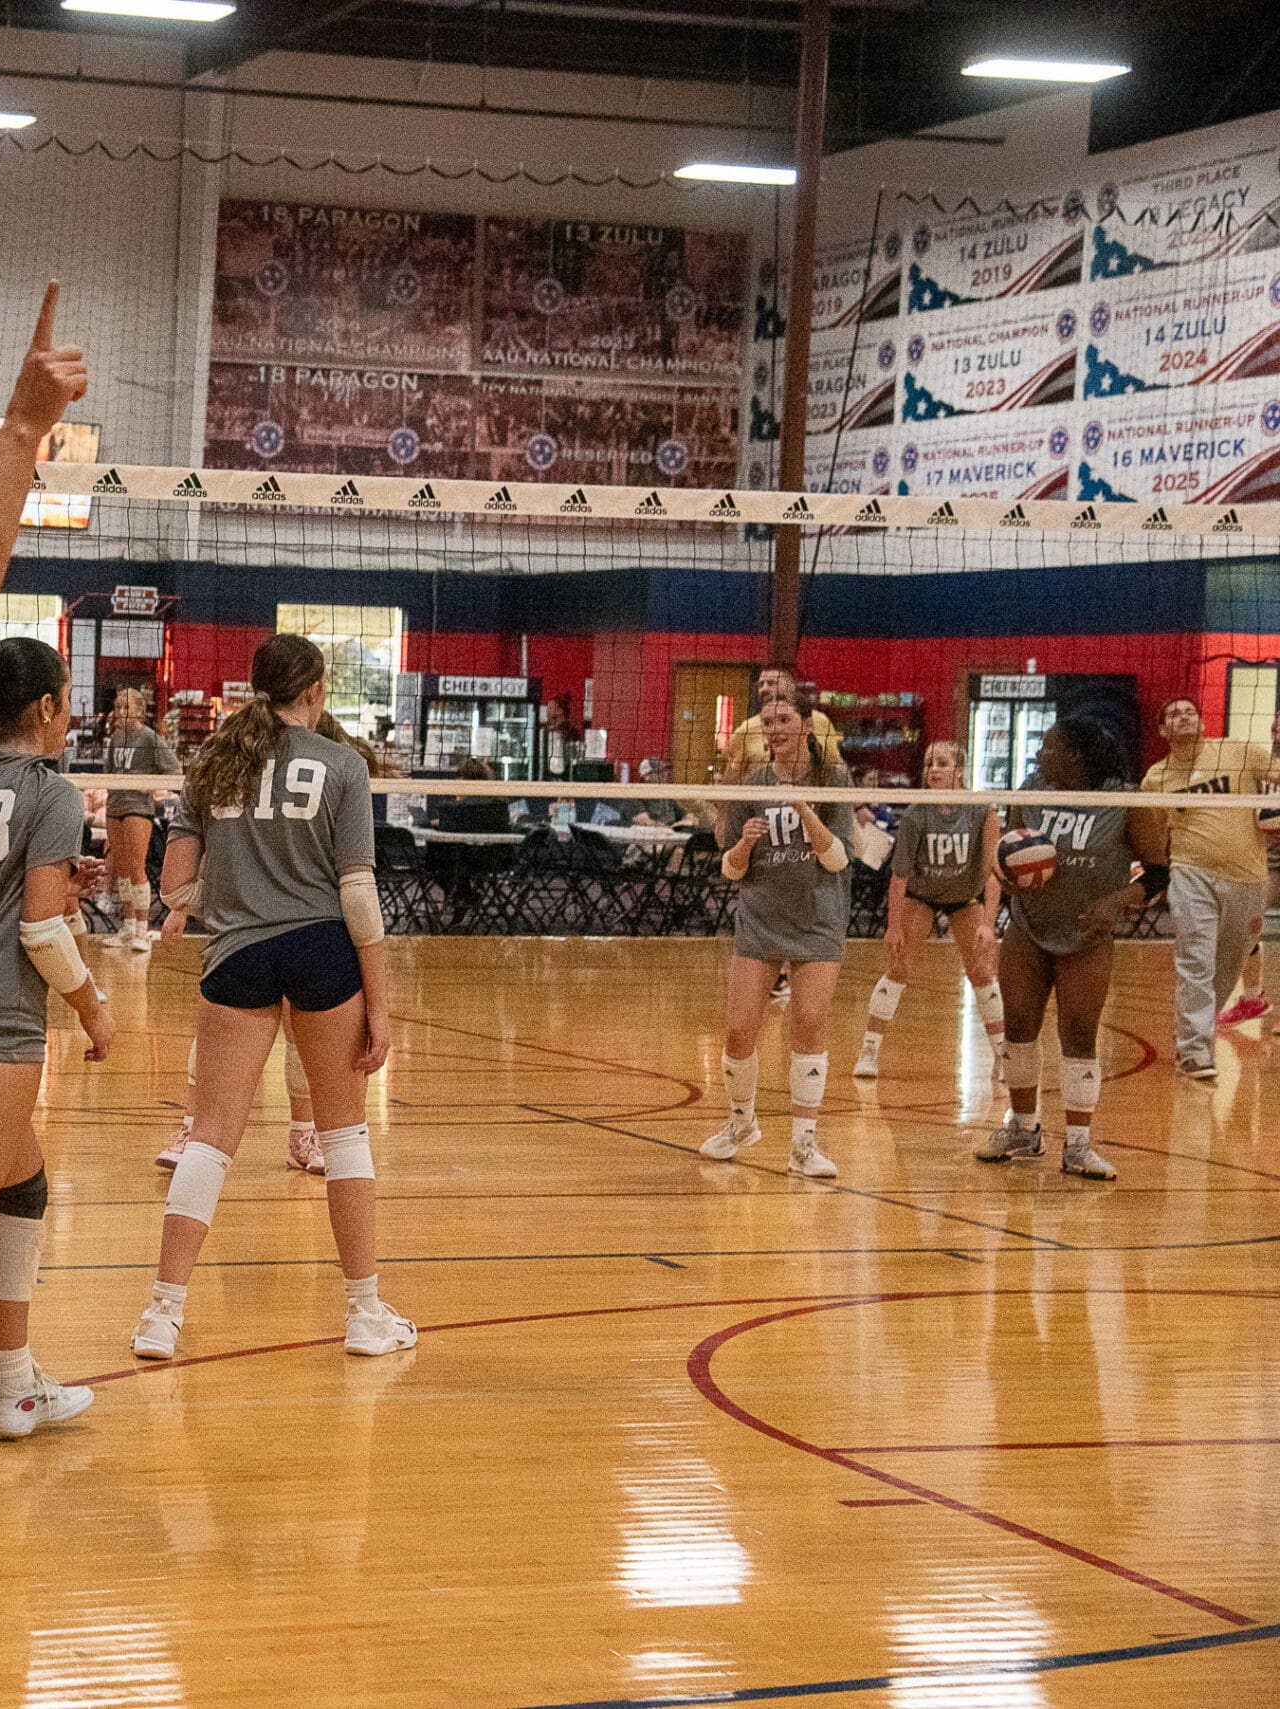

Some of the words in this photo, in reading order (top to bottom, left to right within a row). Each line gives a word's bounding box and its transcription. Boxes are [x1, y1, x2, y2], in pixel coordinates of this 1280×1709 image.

[1196, 165, 1241, 186] PLACE
[1169, 186, 1249, 220] LEGACY
[261, 205, 288, 224] 18
[299, 207, 420, 232] PARAGON
[566, 224, 591, 242] 13
[600, 226, 663, 246] ZULU
[960, 242, 977, 262] 14
[983, 233, 1028, 260] ZULU
[971, 263, 1013, 288] 2019
[1114, 301, 1177, 321] NATIONAL
[930, 335, 987, 352] NATIONAL
[989, 324, 1048, 343] CHAMPION
[1145, 325, 1166, 346] 14
[1172, 316, 1226, 342] ZULU
[481, 350, 519, 364] AAU
[525, 350, 619, 370] NATIONAL
[953, 357, 971, 375] 13
[977, 349, 1022, 371] ZULU
[1159, 347, 1208, 373] 2024
[258, 366, 286, 383] 18
[295, 367, 419, 391] PARAGON
[965, 378, 1007, 400] 2023
[1107, 423, 1170, 441] NATIONAL
[922, 447, 975, 461] NATIONAL
[1113, 450, 1132, 468] 16
[1140, 438, 1246, 466] MAVERICK
[926, 470, 944, 487] 17
[948, 461, 1037, 485] MAVERICK
[1152, 471, 1201, 493] 2025
[92, 483, 128, 494] adidas
[172, 487, 208, 498] adidas
[251, 490, 286, 501] adidas
[330, 495, 364, 505] adidas
[408, 498, 441, 509] adidas
[484, 501, 518, 511] adidas
[560, 503, 593, 513] adidas
[634, 505, 667, 516] adidas
[709, 508, 741, 518] adidas
[782, 511, 814, 521] adidas
[855, 513, 887, 523] adidas
[927, 515, 959, 525] adidas
[999, 518, 1031, 528] adidas
[1070, 520, 1102, 530] adidas
[1141, 522, 1173, 531] adidas
[1212, 523, 1243, 533] adidas
[1037, 809, 1096, 850] TPV
[926, 832, 970, 866] TPV
